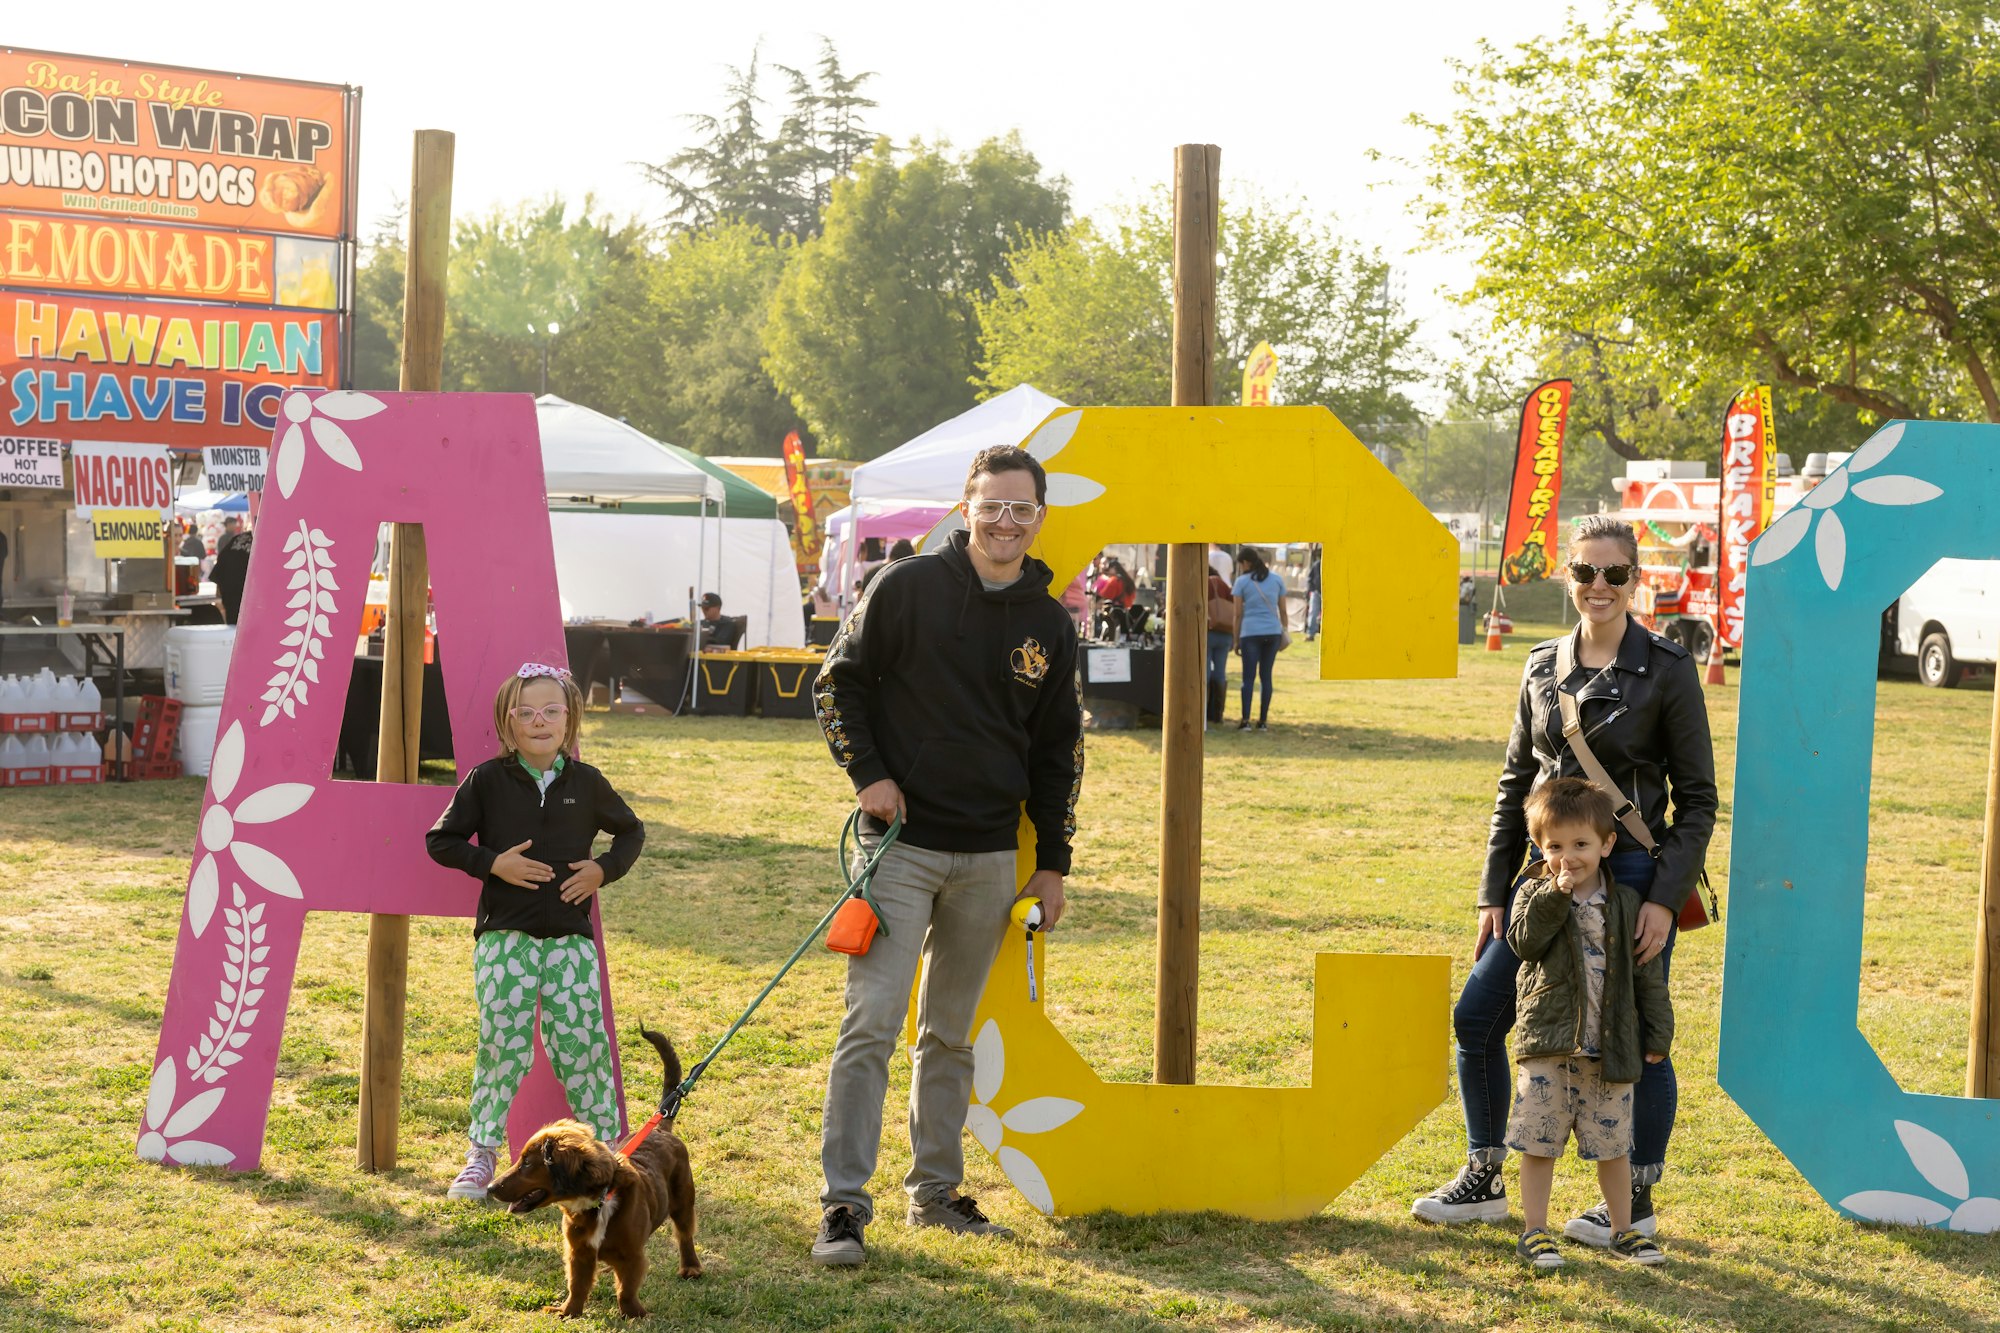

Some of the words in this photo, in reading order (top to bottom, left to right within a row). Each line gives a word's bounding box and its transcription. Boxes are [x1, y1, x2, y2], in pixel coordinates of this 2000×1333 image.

[25, 61, 124, 101] Baja
[134, 73, 224, 110] Style
[0, 87, 139, 146] CON
[148, 101, 332, 165] WRAP
[63, 193, 99, 210] With
[101, 197, 148, 215] Grilled
[151, 202, 198, 218] Onions
[109, 153, 173, 199] HOT
[177, 160, 257, 208] DOGS
[0, 218, 271, 299] EMONADE
[14, 299, 323, 375] HAWAIIAN
[9, 367, 207, 427] SHAVE
[221, 381, 328, 431] IC
[0, 438, 58, 457] OFFEE
[14, 458, 38, 470] HOT
[210, 447, 261, 467] MONSTER
[1523, 387, 1562, 546] QUESABIRRIA
[0, 472, 61, 487] HOCOLATE
[74, 455, 171, 509] NACHOS
[93, 521, 161, 542] LEMONADE
